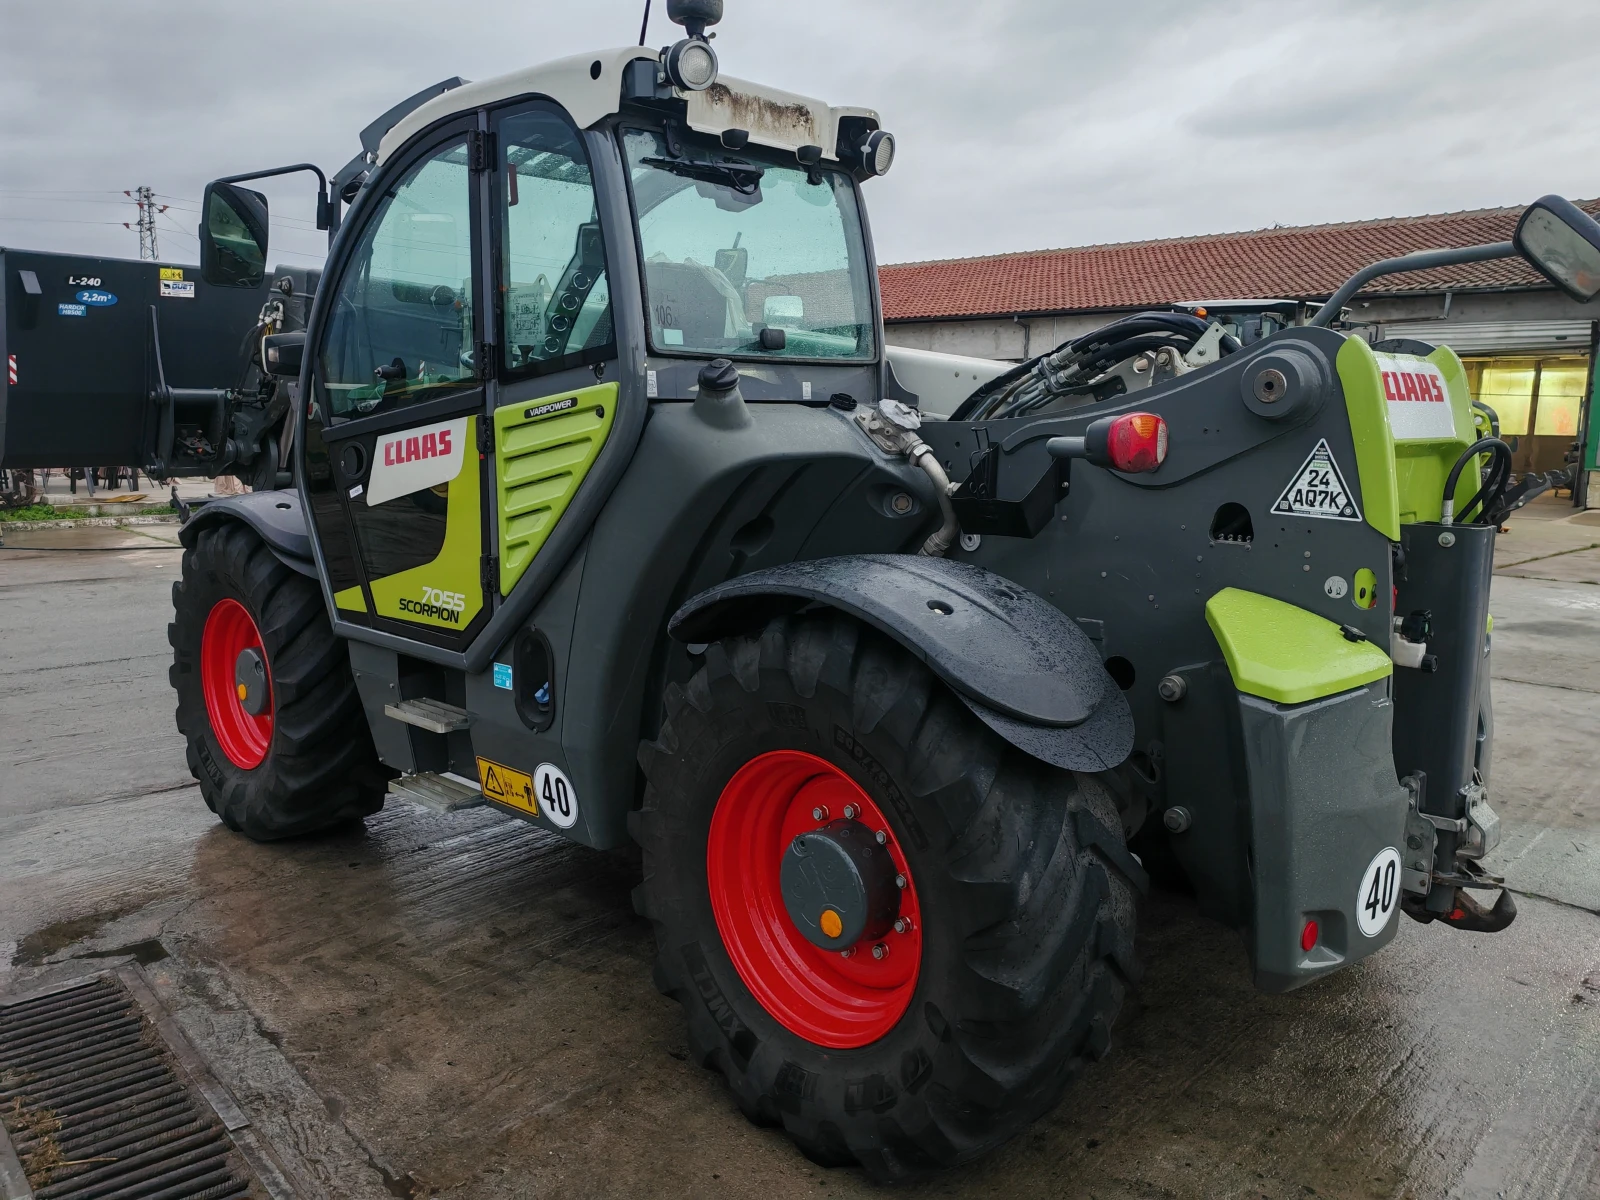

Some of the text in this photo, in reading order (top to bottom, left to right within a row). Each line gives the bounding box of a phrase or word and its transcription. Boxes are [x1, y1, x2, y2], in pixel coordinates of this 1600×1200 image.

[69, 276, 102, 287] L-240
[59, 303, 86, 311] HARDOX
[655, 305, 673, 326] 106
[1381, 370, 1445, 402] CLAAS
[529, 399, 572, 417] VARIPOWER
[384, 429, 452, 467] CLAAS
[1307, 469, 1331, 488] 24
[1293, 488, 1342, 510] AQ7K
[398, 598, 460, 624] SCORPION
[422, 586, 466, 612] 7055
[542, 772, 571, 817] 40
[1364, 859, 1396, 921] 40
[693, 964, 746, 1039] XMCL
